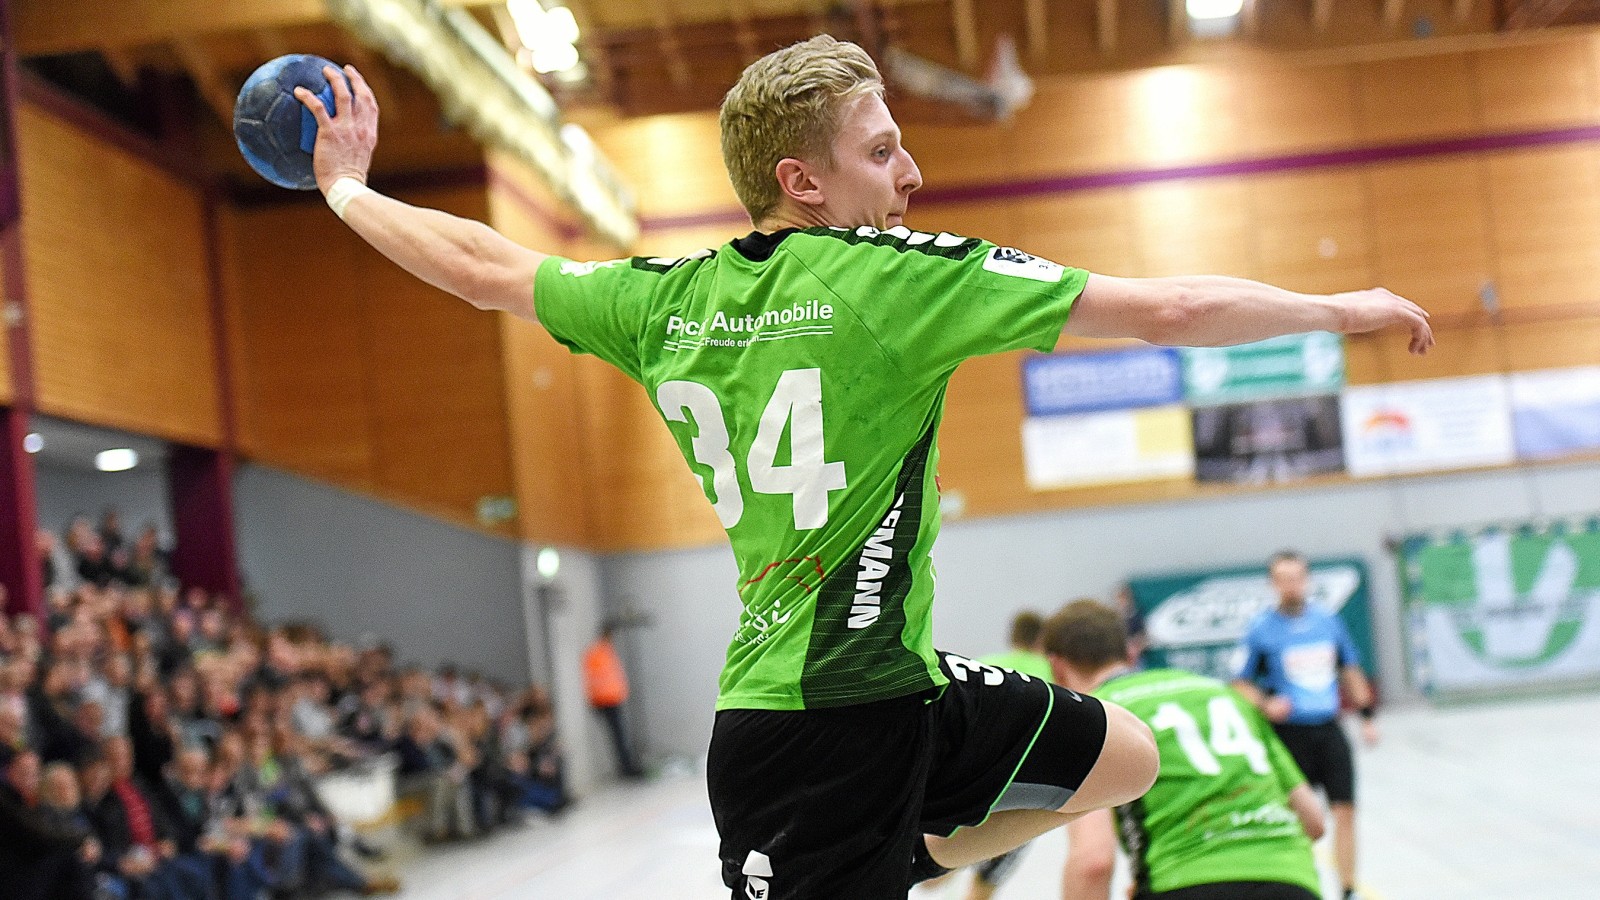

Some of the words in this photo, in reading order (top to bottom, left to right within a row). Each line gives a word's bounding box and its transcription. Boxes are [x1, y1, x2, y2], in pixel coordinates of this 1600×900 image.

[704, 336, 736, 348] Freude
[709, 300, 834, 333] Automobile
[656, 367, 848, 531] 34
[1151, 696, 1272, 776] 14
